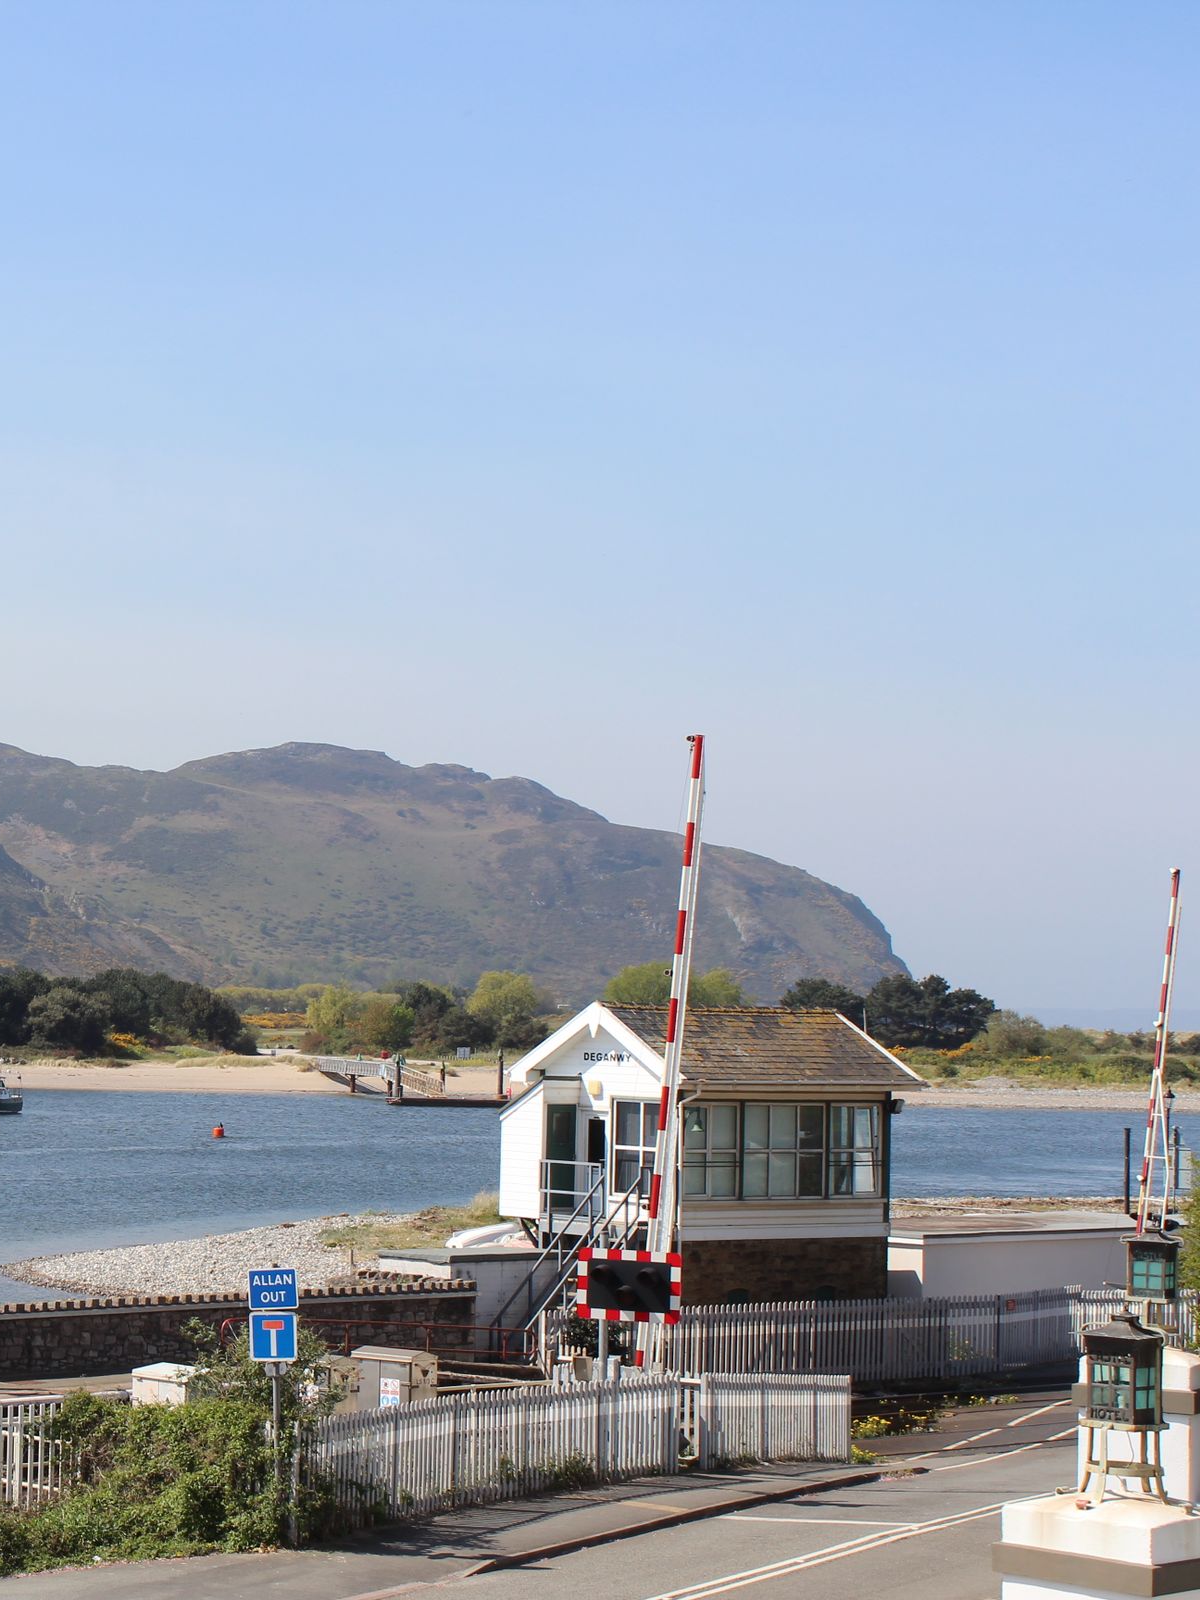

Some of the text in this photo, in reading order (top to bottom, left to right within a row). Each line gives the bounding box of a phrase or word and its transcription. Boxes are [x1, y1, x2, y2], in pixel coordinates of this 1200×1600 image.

[583, 1052, 632, 1062] DEGANWY
[252, 1273, 292, 1286] ALLAN
[260, 1291, 286, 1303] OUT
